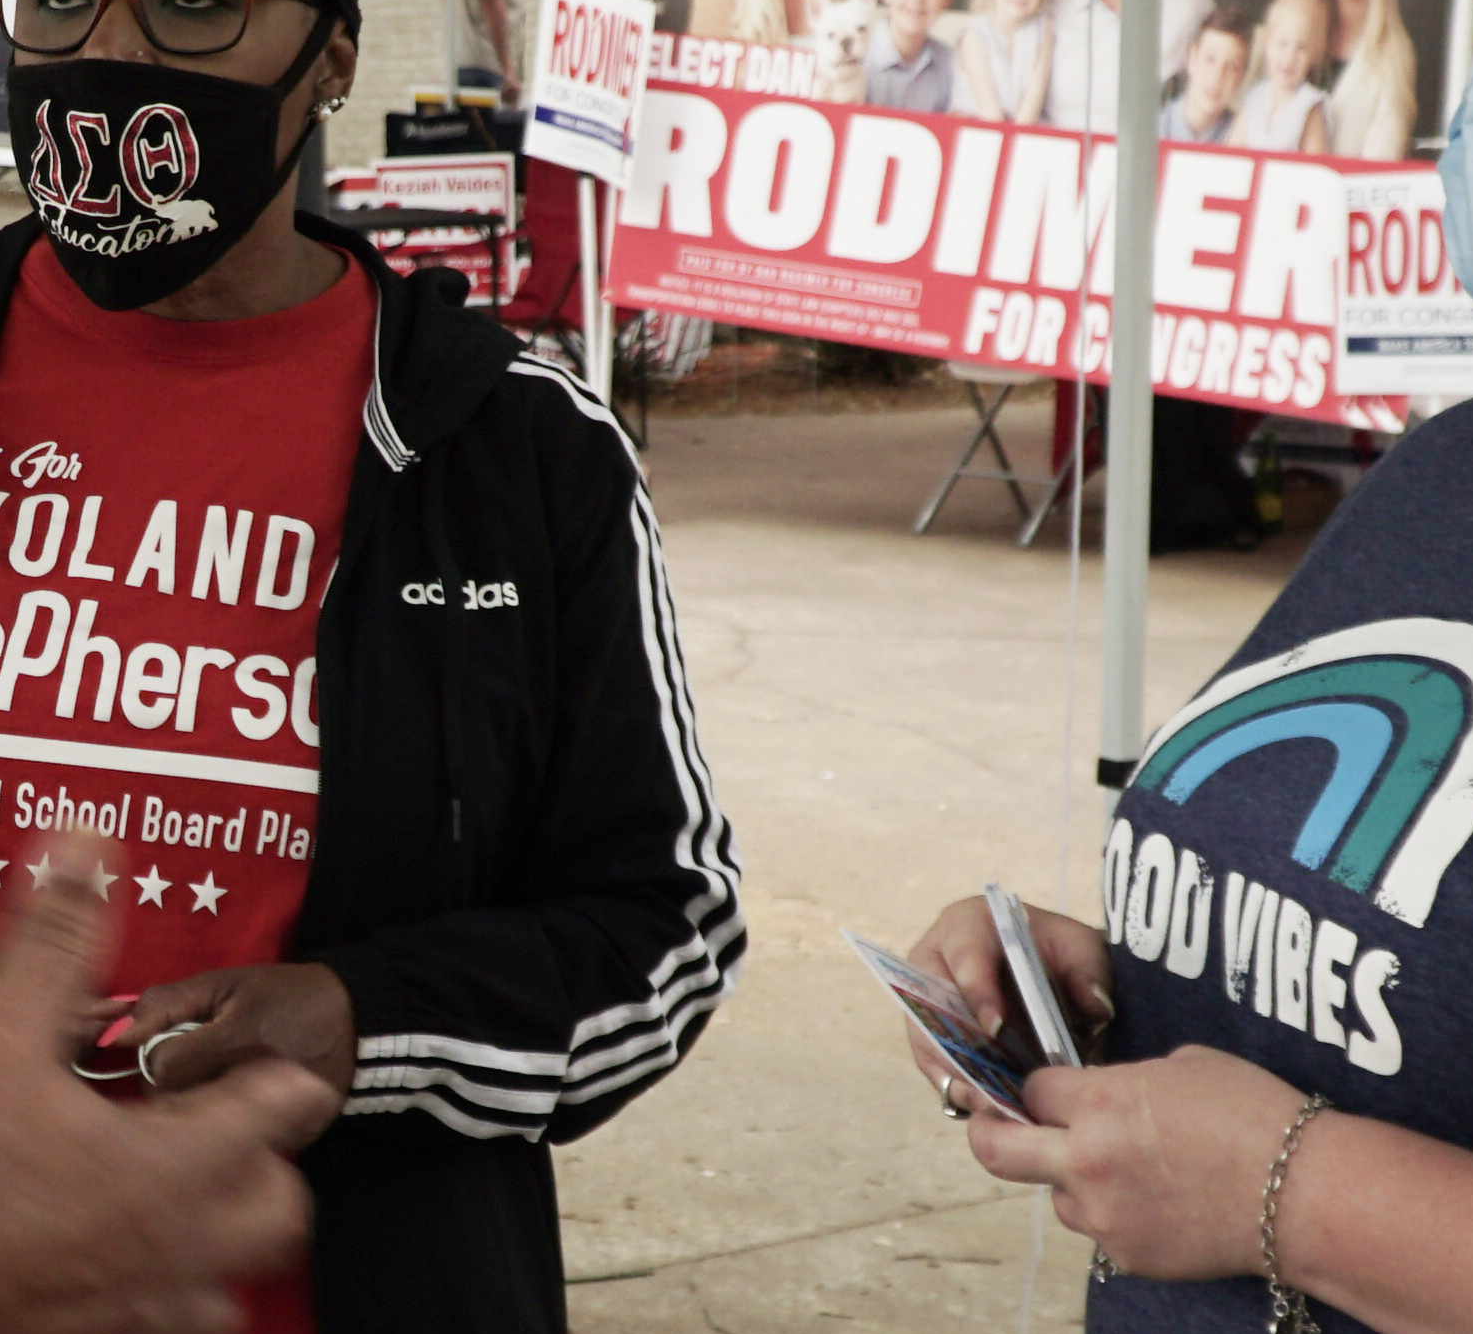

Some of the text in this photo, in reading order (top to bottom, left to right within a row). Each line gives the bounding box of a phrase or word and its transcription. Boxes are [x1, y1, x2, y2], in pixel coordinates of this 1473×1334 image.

[382, 177, 442, 196] Keziah
[619, 87, 1342, 327] RODIMER
[1346, 207, 1462, 298] ROD
[964, 285, 1066, 367] FOR
[1071, 299, 1331, 408] CNGRESS
[401, 576, 520, 611] addas
[13, 781, 132, 841] School
[141, 795, 247, 855] Board
[255, 809, 317, 863] Pla
[1105, 818, 1403, 1077] OOD VIBES
